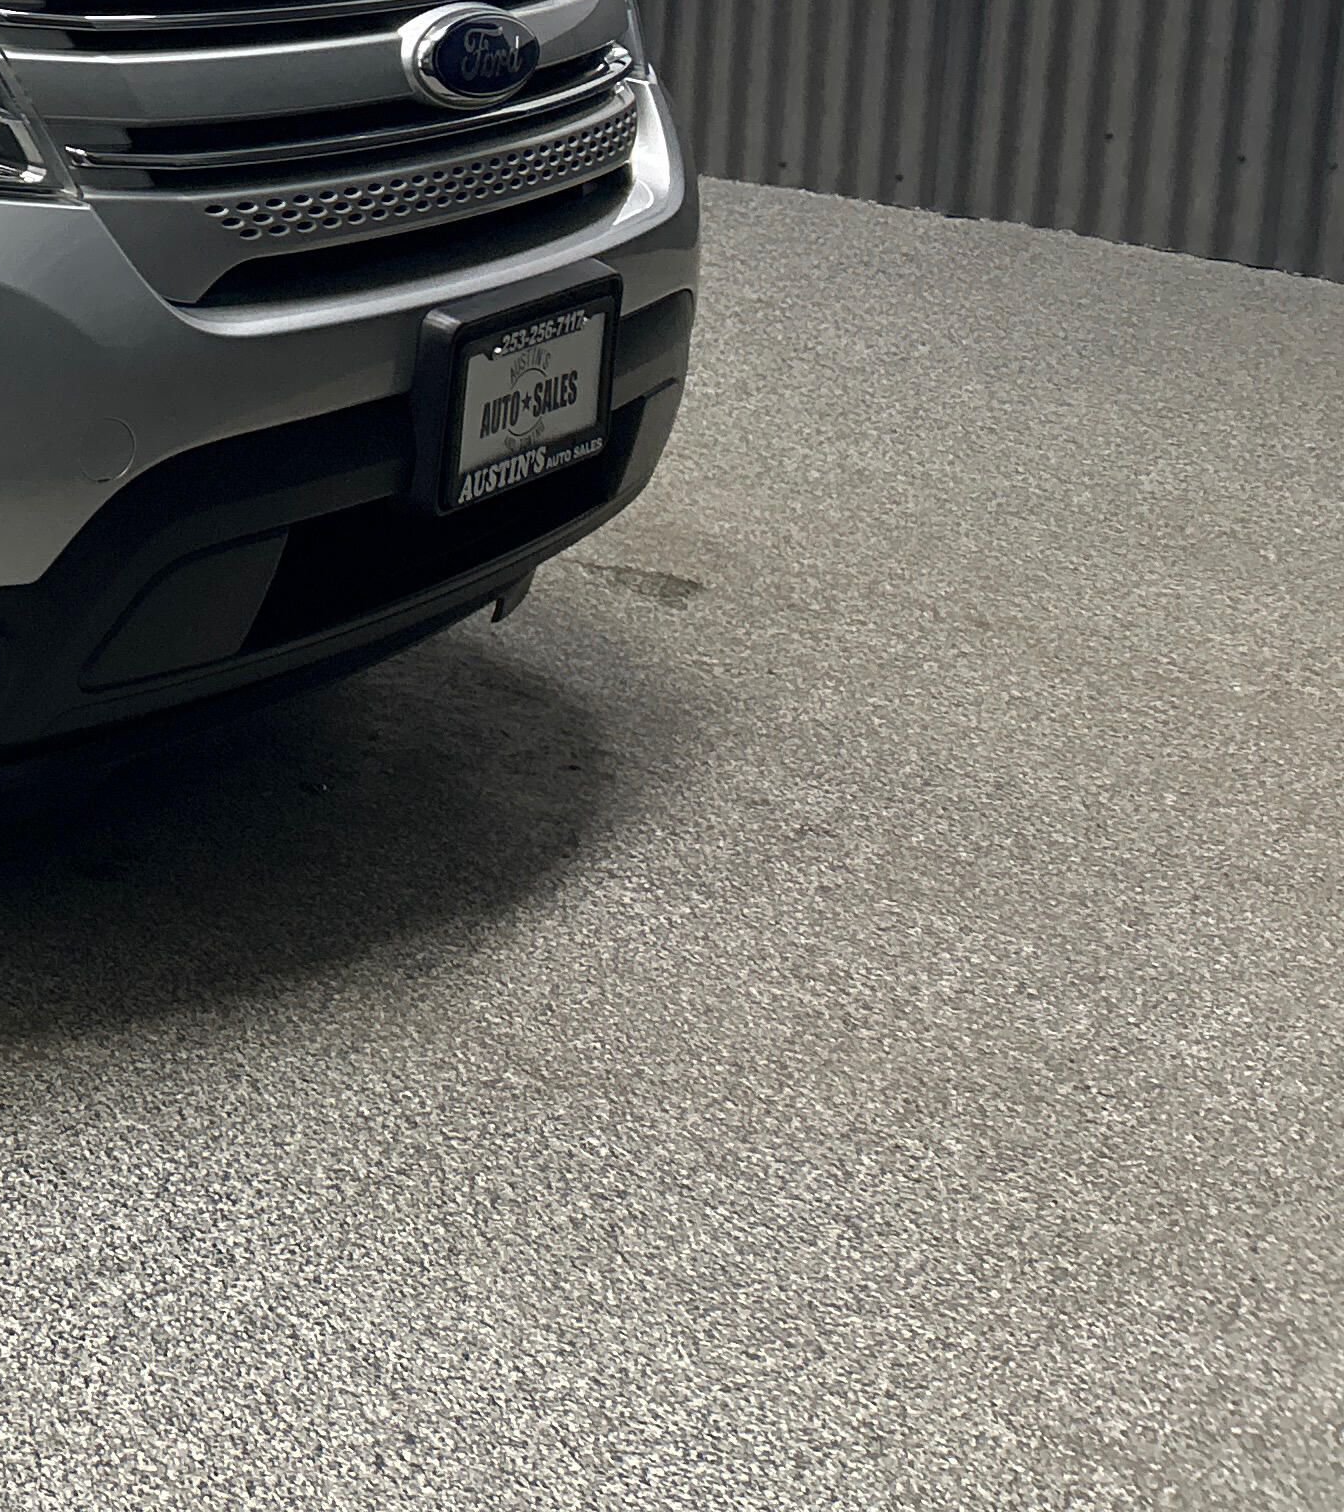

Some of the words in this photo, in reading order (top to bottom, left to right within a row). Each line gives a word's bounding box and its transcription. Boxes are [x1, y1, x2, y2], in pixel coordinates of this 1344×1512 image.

[462, 26, 523, 81] Ford
[480, 390, 521, 439] AUTO
[533, 369, 578, 418] SALES
[457, 445, 547, 505] AUSTIN'S
[546, 450, 572, 470] AUTO
[573, 437, 604, 460] SALES
